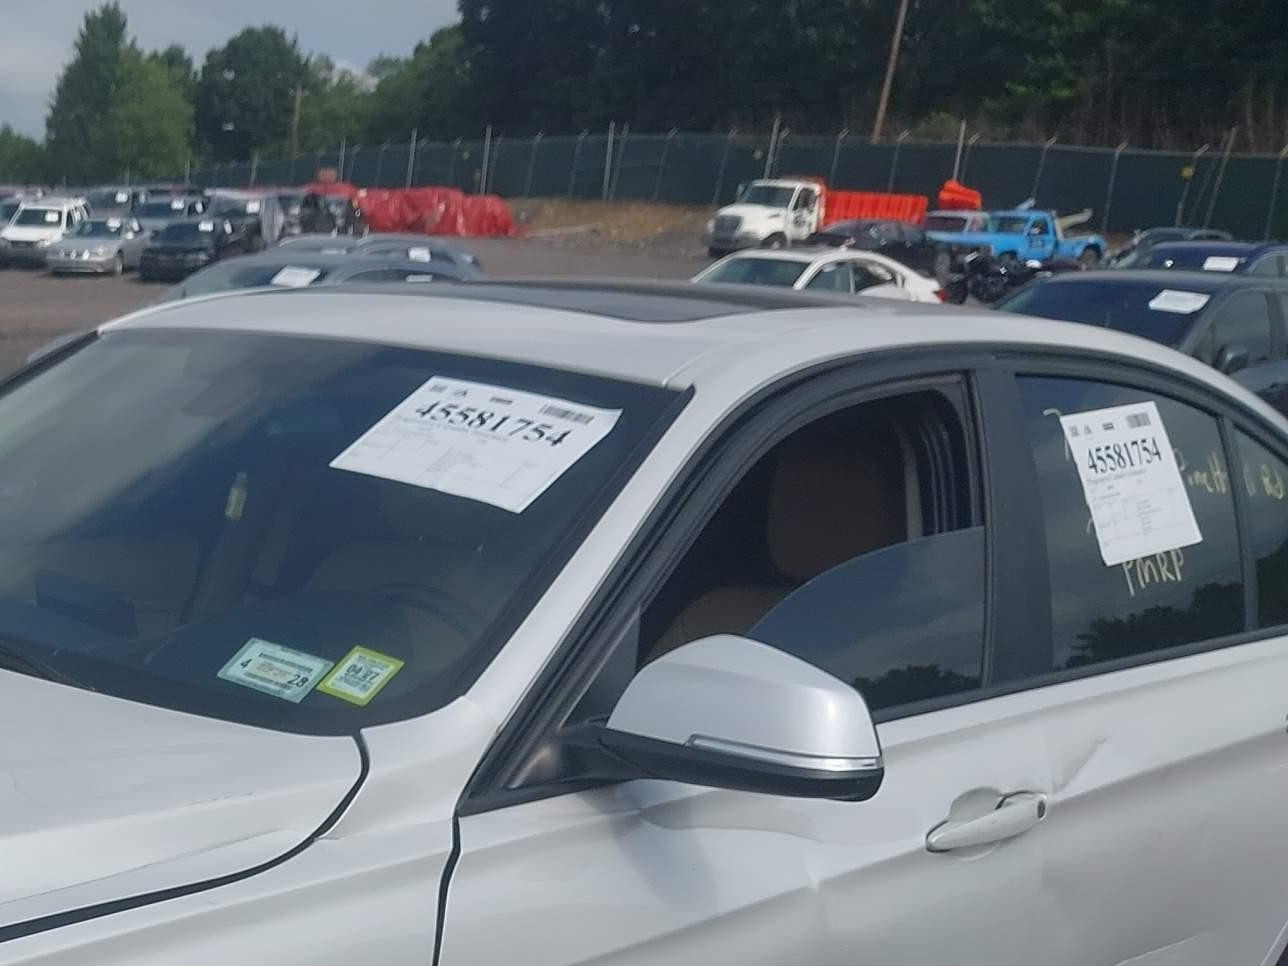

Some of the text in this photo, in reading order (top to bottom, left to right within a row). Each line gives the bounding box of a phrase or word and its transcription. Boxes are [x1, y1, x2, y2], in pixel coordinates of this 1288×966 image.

[415, 400, 572, 448] 45581754
[1086, 436, 1163, 474] 45581754
[287, 673, 309, 688] 28
